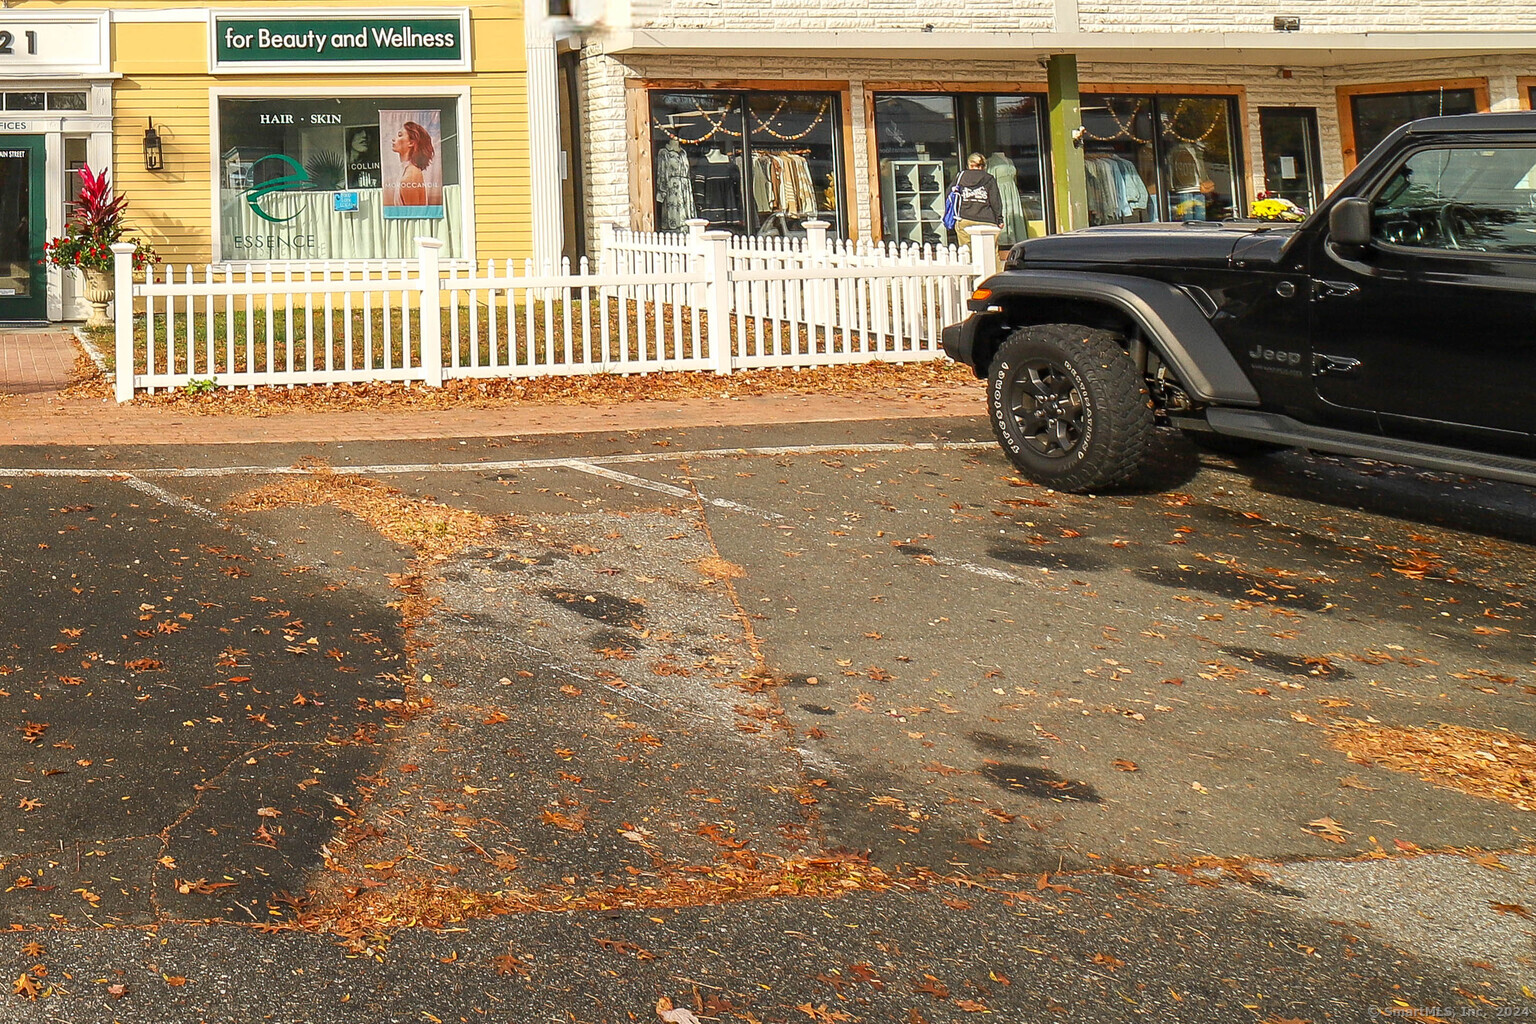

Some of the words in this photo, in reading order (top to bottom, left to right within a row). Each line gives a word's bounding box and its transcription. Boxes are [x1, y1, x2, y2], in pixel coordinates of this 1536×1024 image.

[225, 27, 253, 49] for
[259, 28, 327, 52] Beauty
[331, 26, 368, 49] and
[372, 26, 455, 48] Wellness
[260, 114, 294, 124] HAIR
[310, 114, 342, 124] SKIN
[9, 150, 26, 158] STREET
[234, 235, 315, 249] ESSENCE
[1248, 344, 1301, 366] Jeep
